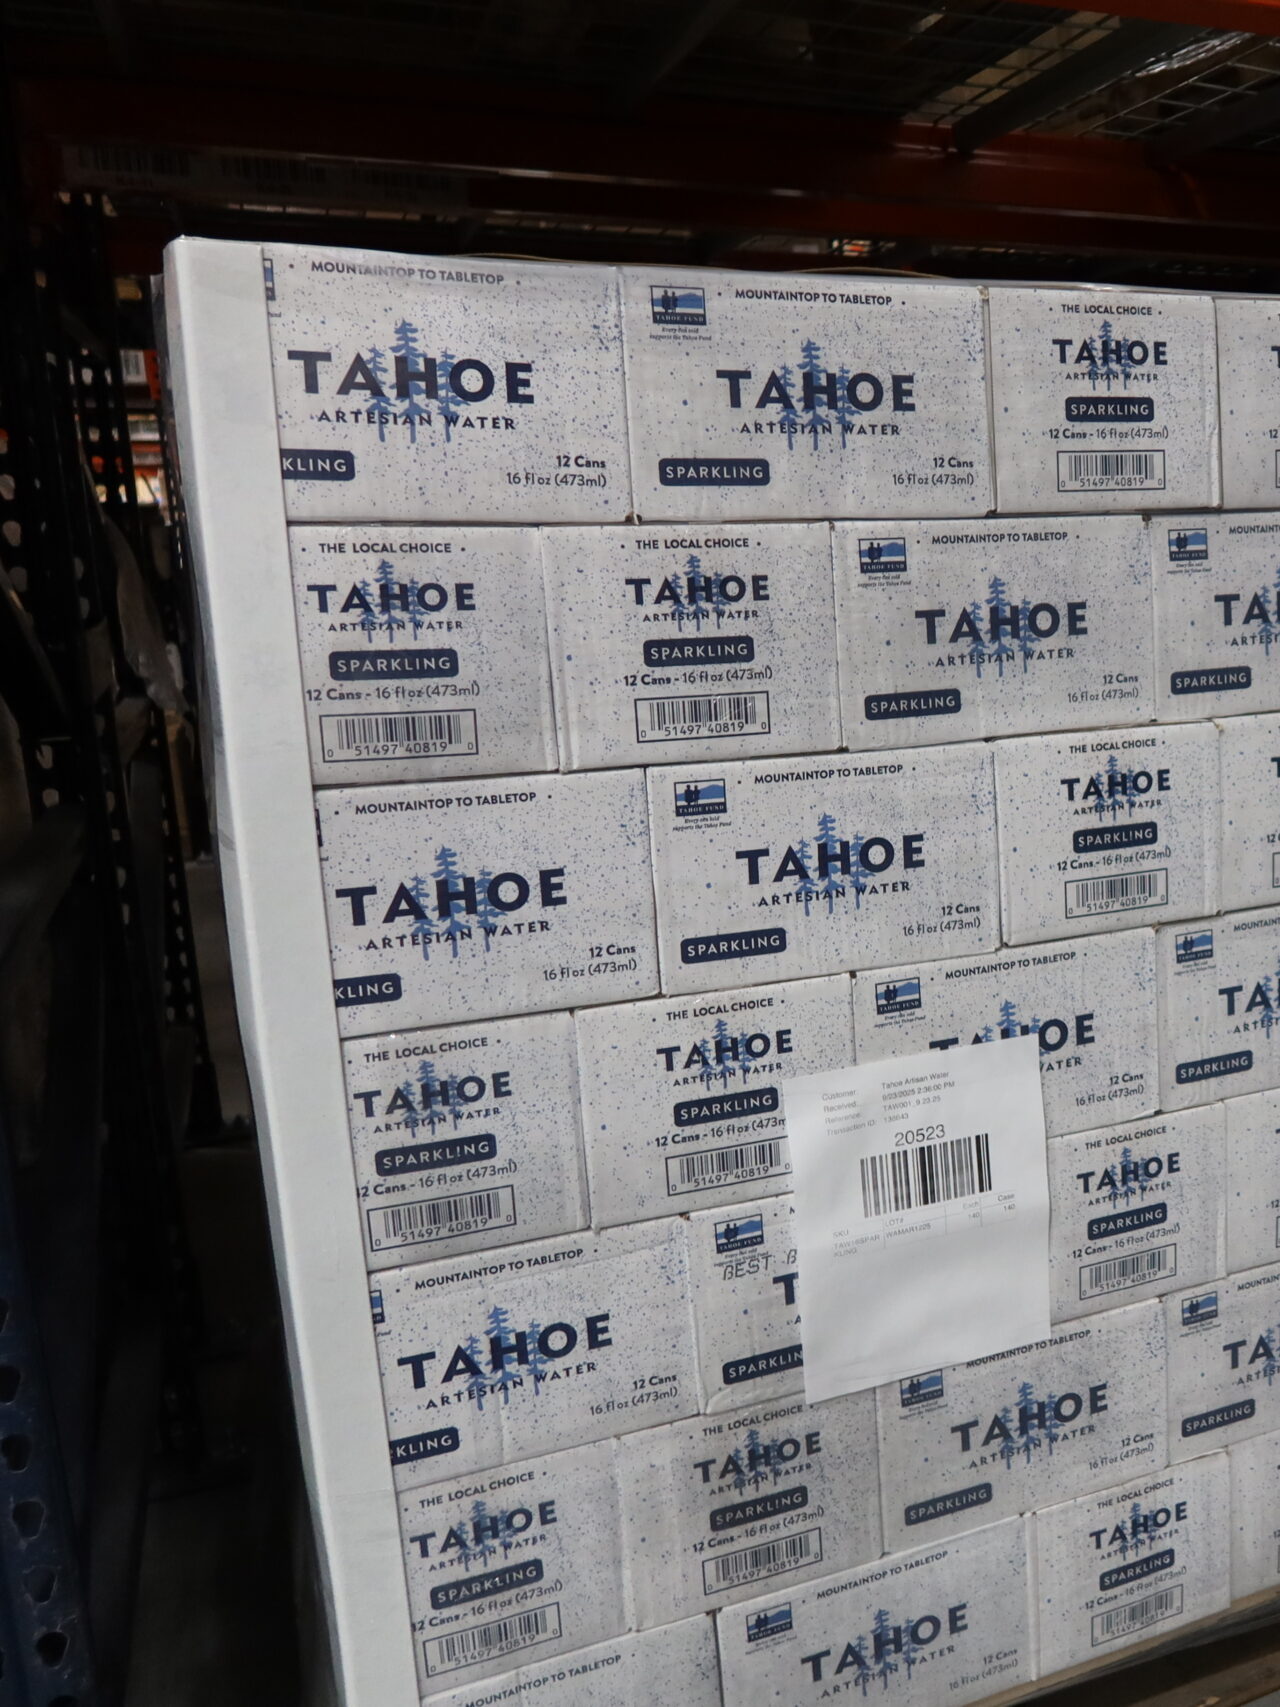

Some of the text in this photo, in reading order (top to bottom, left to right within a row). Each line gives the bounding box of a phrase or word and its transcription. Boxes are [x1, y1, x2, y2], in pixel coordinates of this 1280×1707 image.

[735, 289, 892, 305] MOUNTAINTOP TO TABLETOP
[1061, 305, 1152, 315] THE LOCAL CHOICE
[1052, 339, 1168, 365] TAHOE
[288, 350, 534, 404] TAHOE
[716, 369, 916, 411] TAHOE
[318, 410, 516, 430] ARTESIAN WATER
[1071, 404, 1149, 416] SPARKLING
[740, 422, 900, 435] ARTESIAN WATER
[666, 466, 764, 479] SPARKLING
[934, 458, 973, 468] 12 Cans
[319, 543, 451, 553] THE LOCAL CHOICE
[932, 532, 1067, 544] MOUNTAINTOP TO TABLETOP
[307, 583, 475, 613] TAHOE
[625, 575, 770, 605] TAHOE
[915, 602, 1088, 644] TAHOE
[337, 657, 450, 672] SPARKLING
[651, 644, 748, 660] SPARKLING
[936, 648, 1074, 667] ARTESIAN WATER
[1176, 673, 1247, 688] SPARKLING
[871, 696, 956, 713] SPARKLING
[664, 722, 744, 736] 51497 40819
[328, 742, 473, 757] 0 51497 40819 0
[1061, 769, 1171, 801] TAHOE
[355, 792, 536, 815] MOUNTAINTOP TO TABLETOP
[1078, 828, 1153, 847] SPARKLING
[735, 834, 925, 885] TAHOE
[335, 868, 567, 926] TAHOE
[366, 920, 550, 950] ARTESIAN WATER
[687, 935, 780, 957] SPARKLING
[589, 944, 636, 958] 12 Cans
[667, 998, 773, 1021] THE LOCAL CHOICE
[657, 1029, 793, 1072] TAHOE
[354, 1071, 512, 1118] TAHOE
[882, 1081, 902, 1089] Tahoe
[681, 1095, 772, 1120] SPARKLING
[895, 1124, 945, 1147] 20523
[383, 1141, 489, 1169] SPARKLING
[1077, 1152, 1180, 1193] TAHOE
[998, 1193, 1015, 1202] Case
[1092, 1209, 1162, 1235] SPARKLING
[415, 1249, 583, 1290] MOUNTAINTOP TO TABLETOP
[397, 1313, 612, 1389] TAHOE
[425, 1362, 596, 1410] ARTESIAN WATER
[951, 1383, 1108, 1452] TAHOE
[693, 1432, 821, 1483] TAHOE
[419, 1471, 535, 1509] THE LOCAL CHOICE
[910, 1489, 988, 1520] SPARKLING
[409, 1500, 557, 1558] TAHOE
[1089, 1502, 1187, 1550] TAHOE
[802, 1604, 968, 1682] TAHOE
